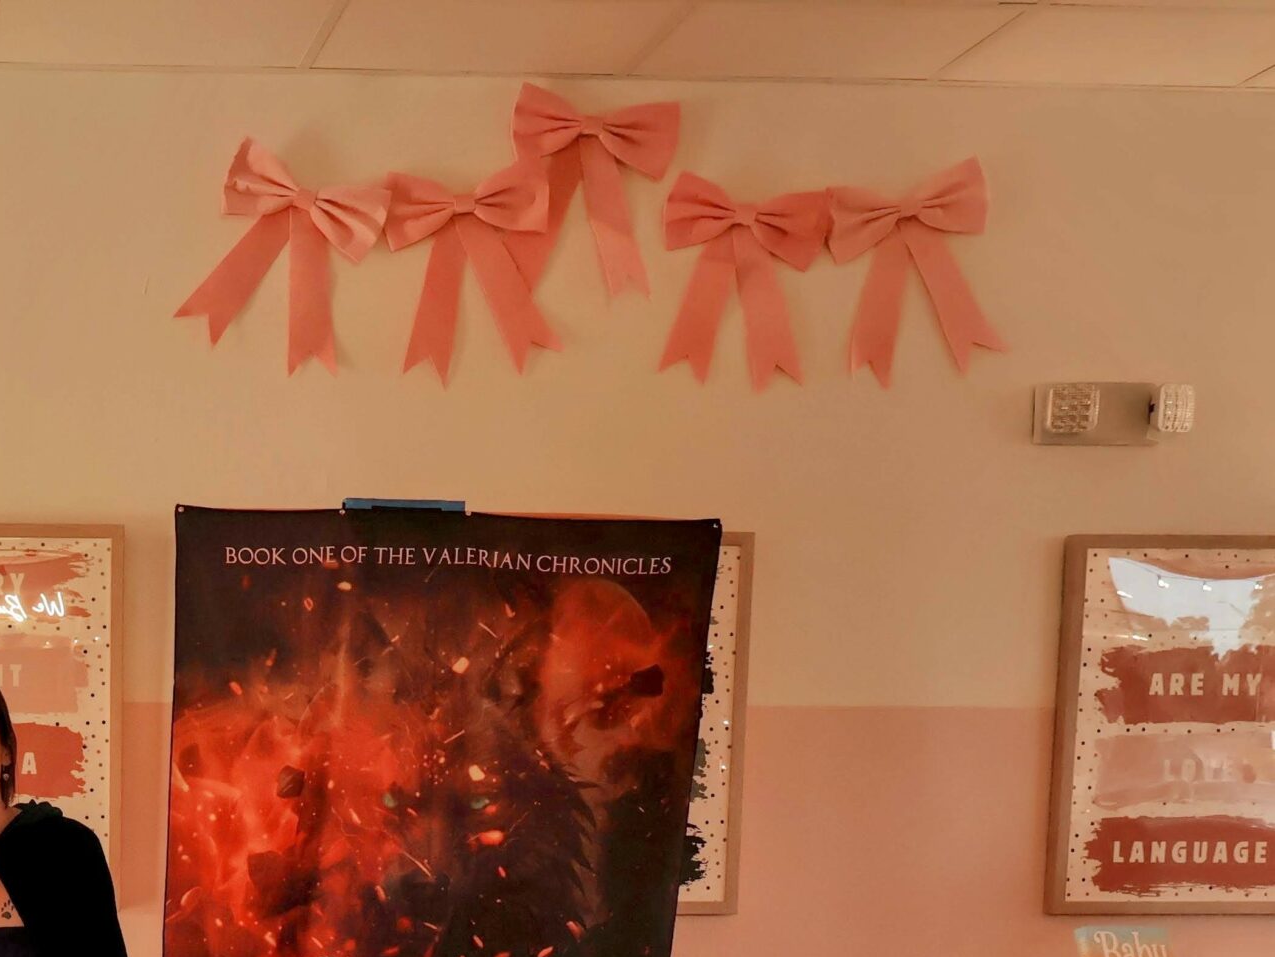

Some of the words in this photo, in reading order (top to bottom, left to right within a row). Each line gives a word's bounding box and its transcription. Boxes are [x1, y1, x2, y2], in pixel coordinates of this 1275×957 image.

[225, 546, 287, 566] BOOK
[292, 546, 336, 564] ONE
[341, 545, 368, 563] OF
[374, 546, 416, 565] THE
[422, 547, 532, 571] VALERIAN
[536, 555, 672, 575] CHRONICLES
[1149, 673, 1205, 696] ARE
[1222, 673, 1263, 696] MY
[21, 752, 37, 775] A
[1163, 759, 1236, 782] LOVE
[1112, 841, 1268, 864] LANGUAGE
